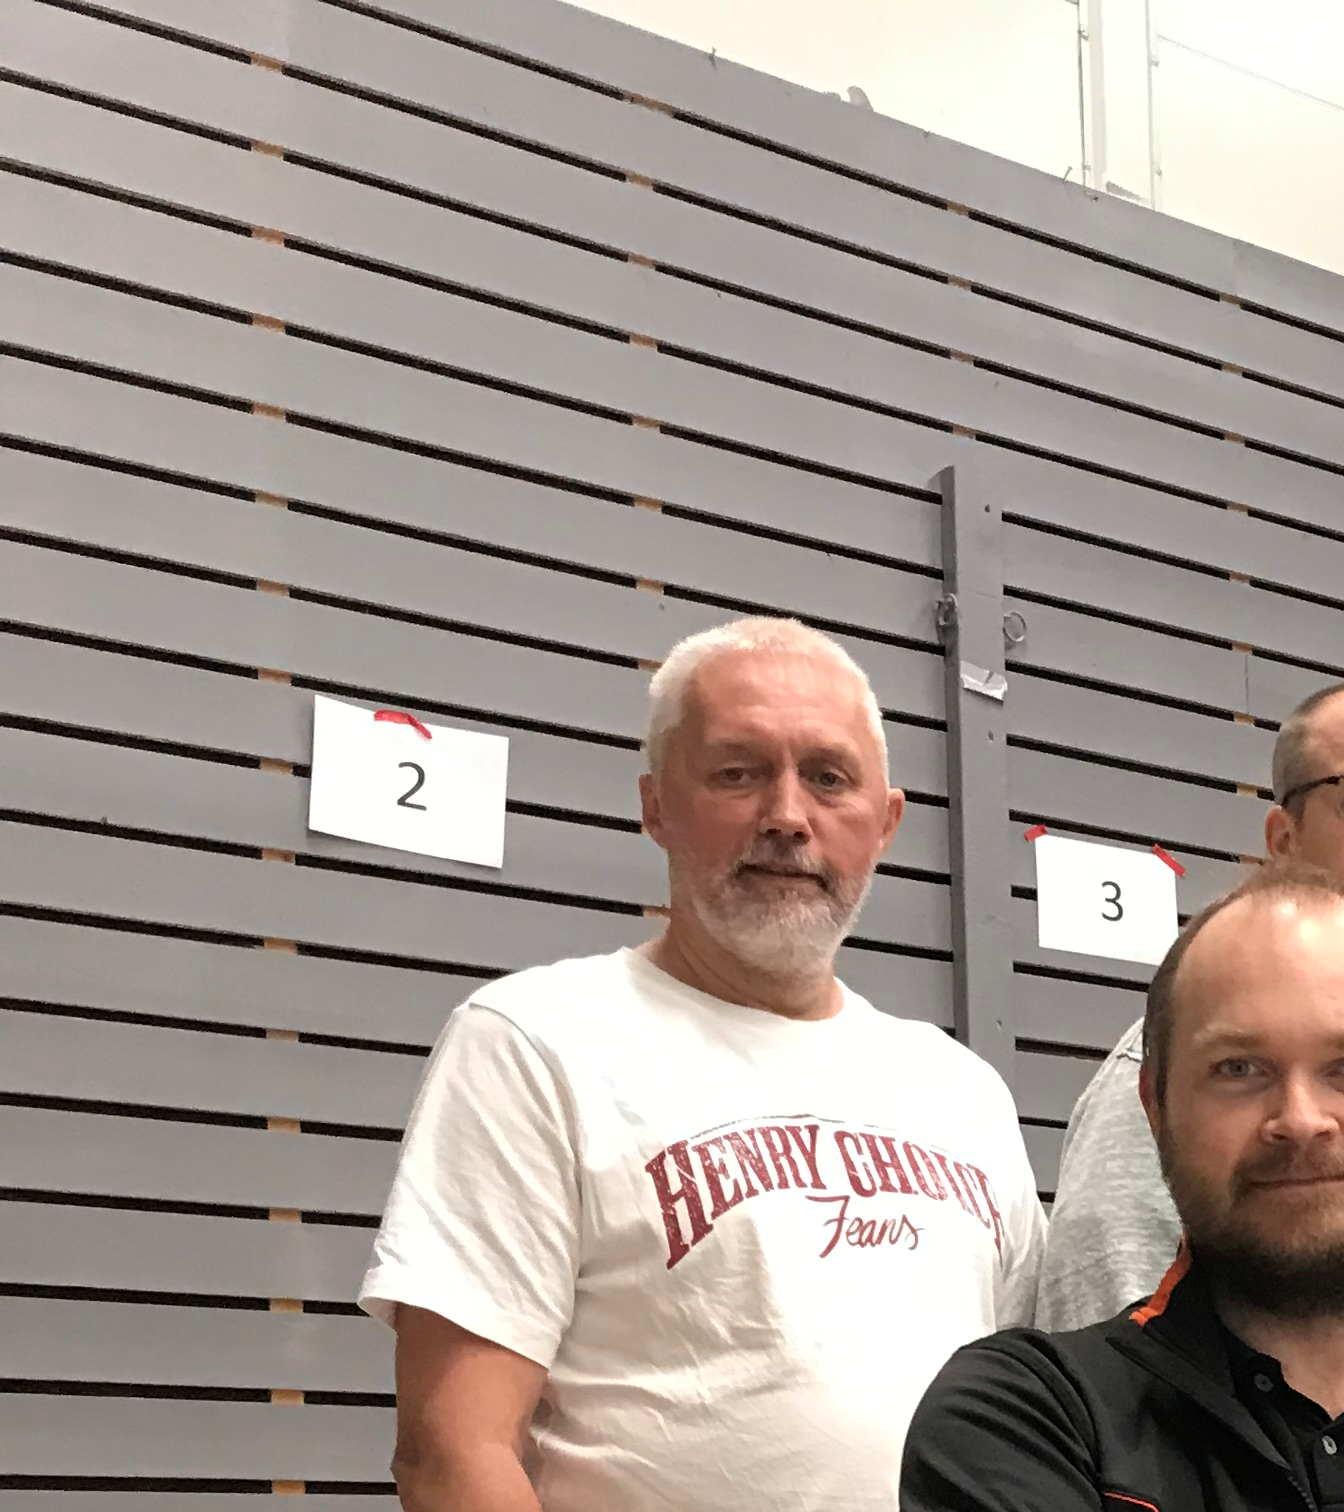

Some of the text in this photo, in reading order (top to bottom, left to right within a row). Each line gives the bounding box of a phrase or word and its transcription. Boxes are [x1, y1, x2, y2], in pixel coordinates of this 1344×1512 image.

[396, 760, 428, 812] 2
[1100, 880, 1124, 922] 3
[645, 1123, 1005, 1270] HENRY CHOICE
[805, 1193, 925, 1260] Jeans
